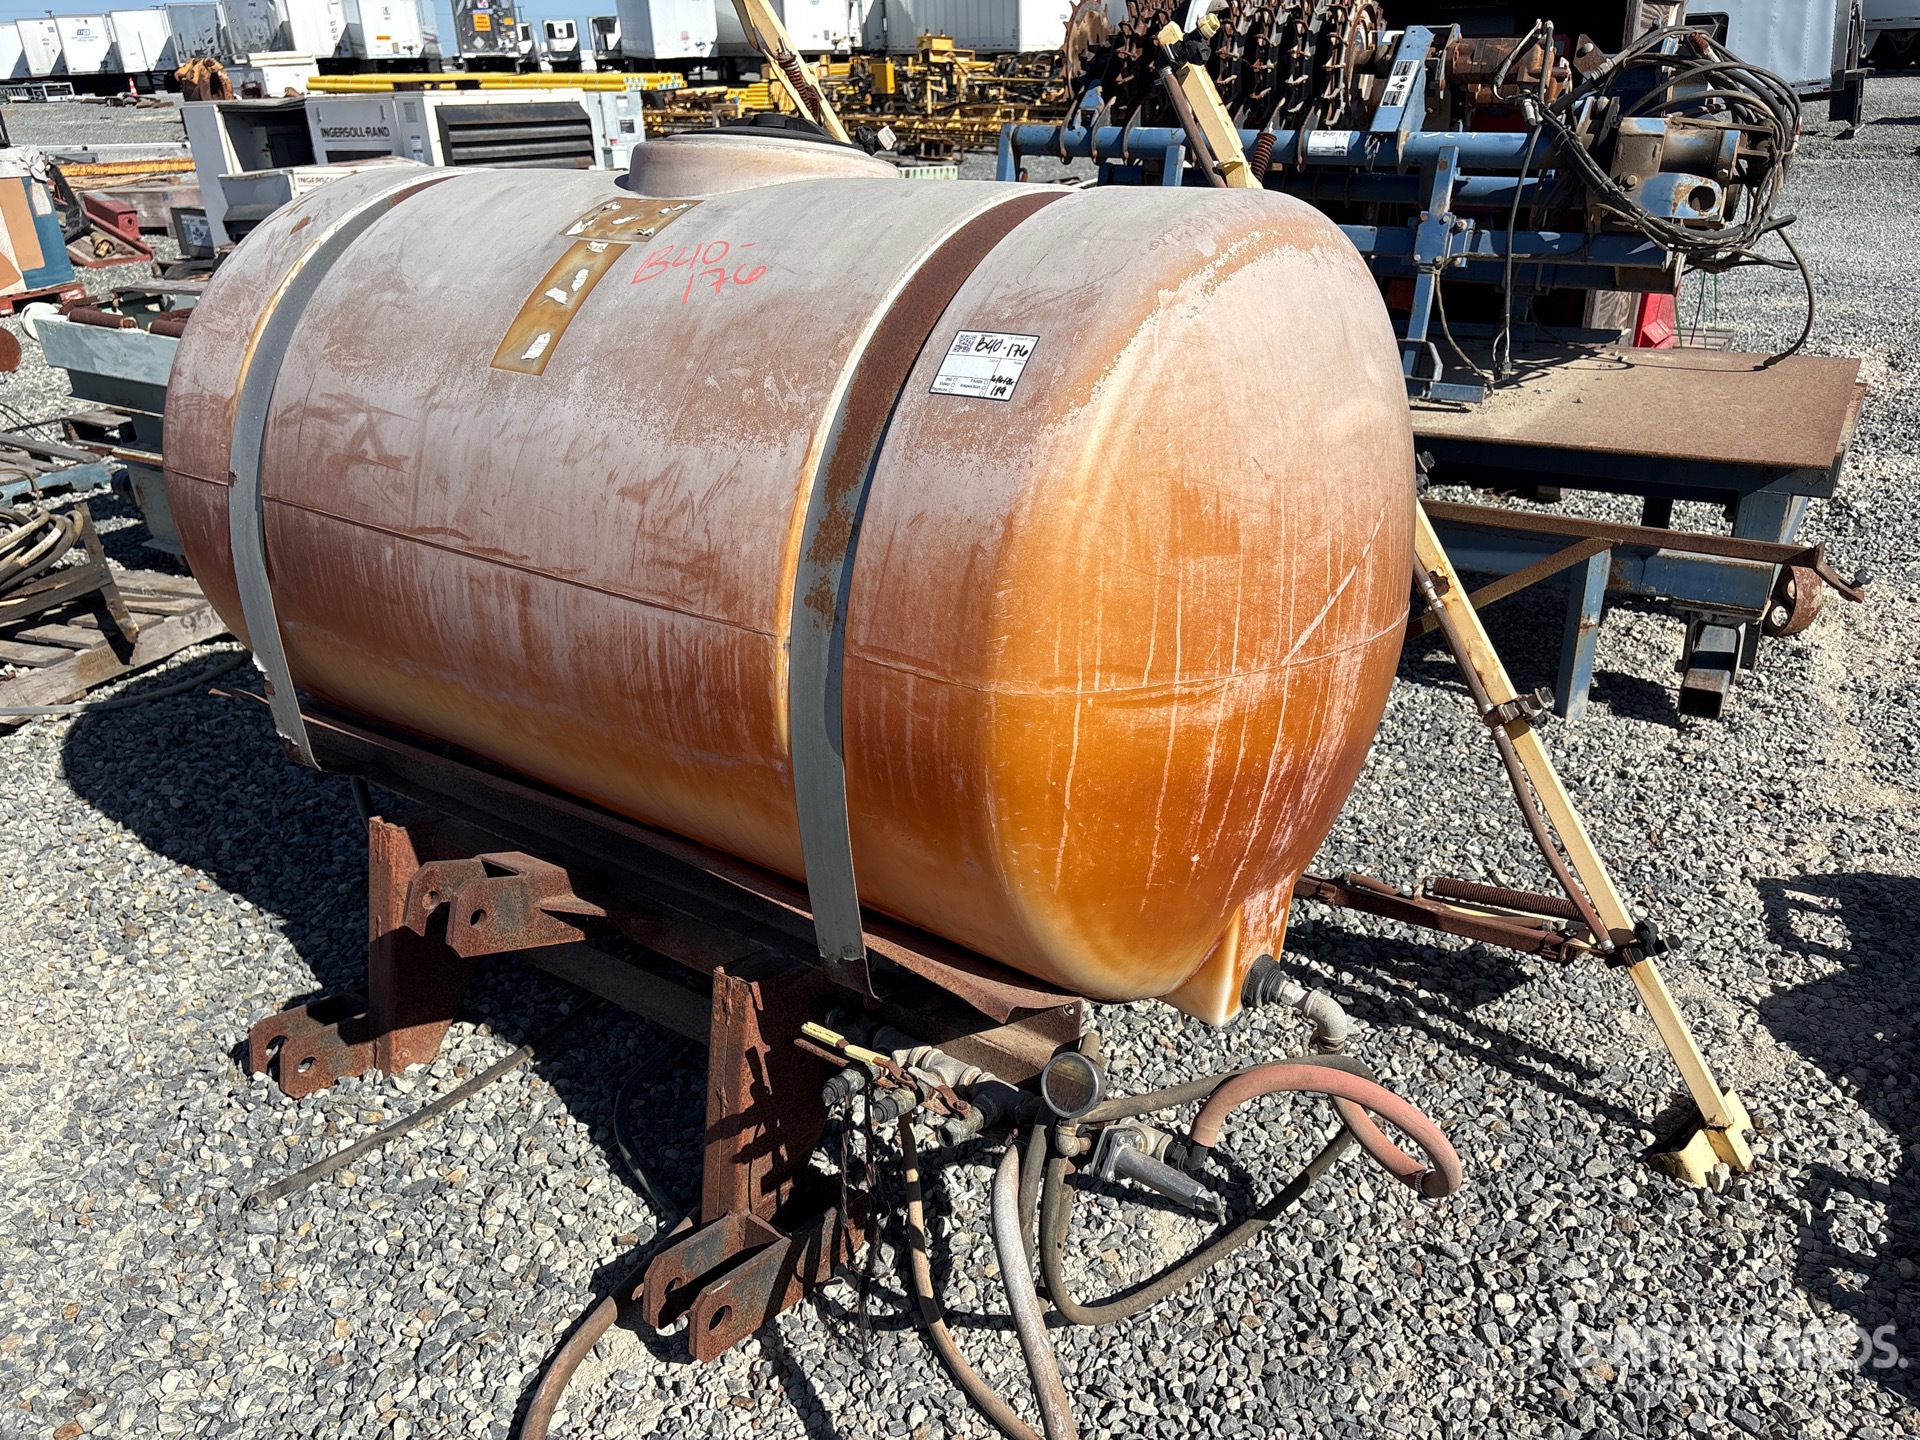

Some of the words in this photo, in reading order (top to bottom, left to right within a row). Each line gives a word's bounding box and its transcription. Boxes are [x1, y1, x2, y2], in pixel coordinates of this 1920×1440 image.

[320, 127, 391, 138] INGERSOLL-RAND
[630, 240, 757, 285] B40-
[682, 263, 768, 305] 176
